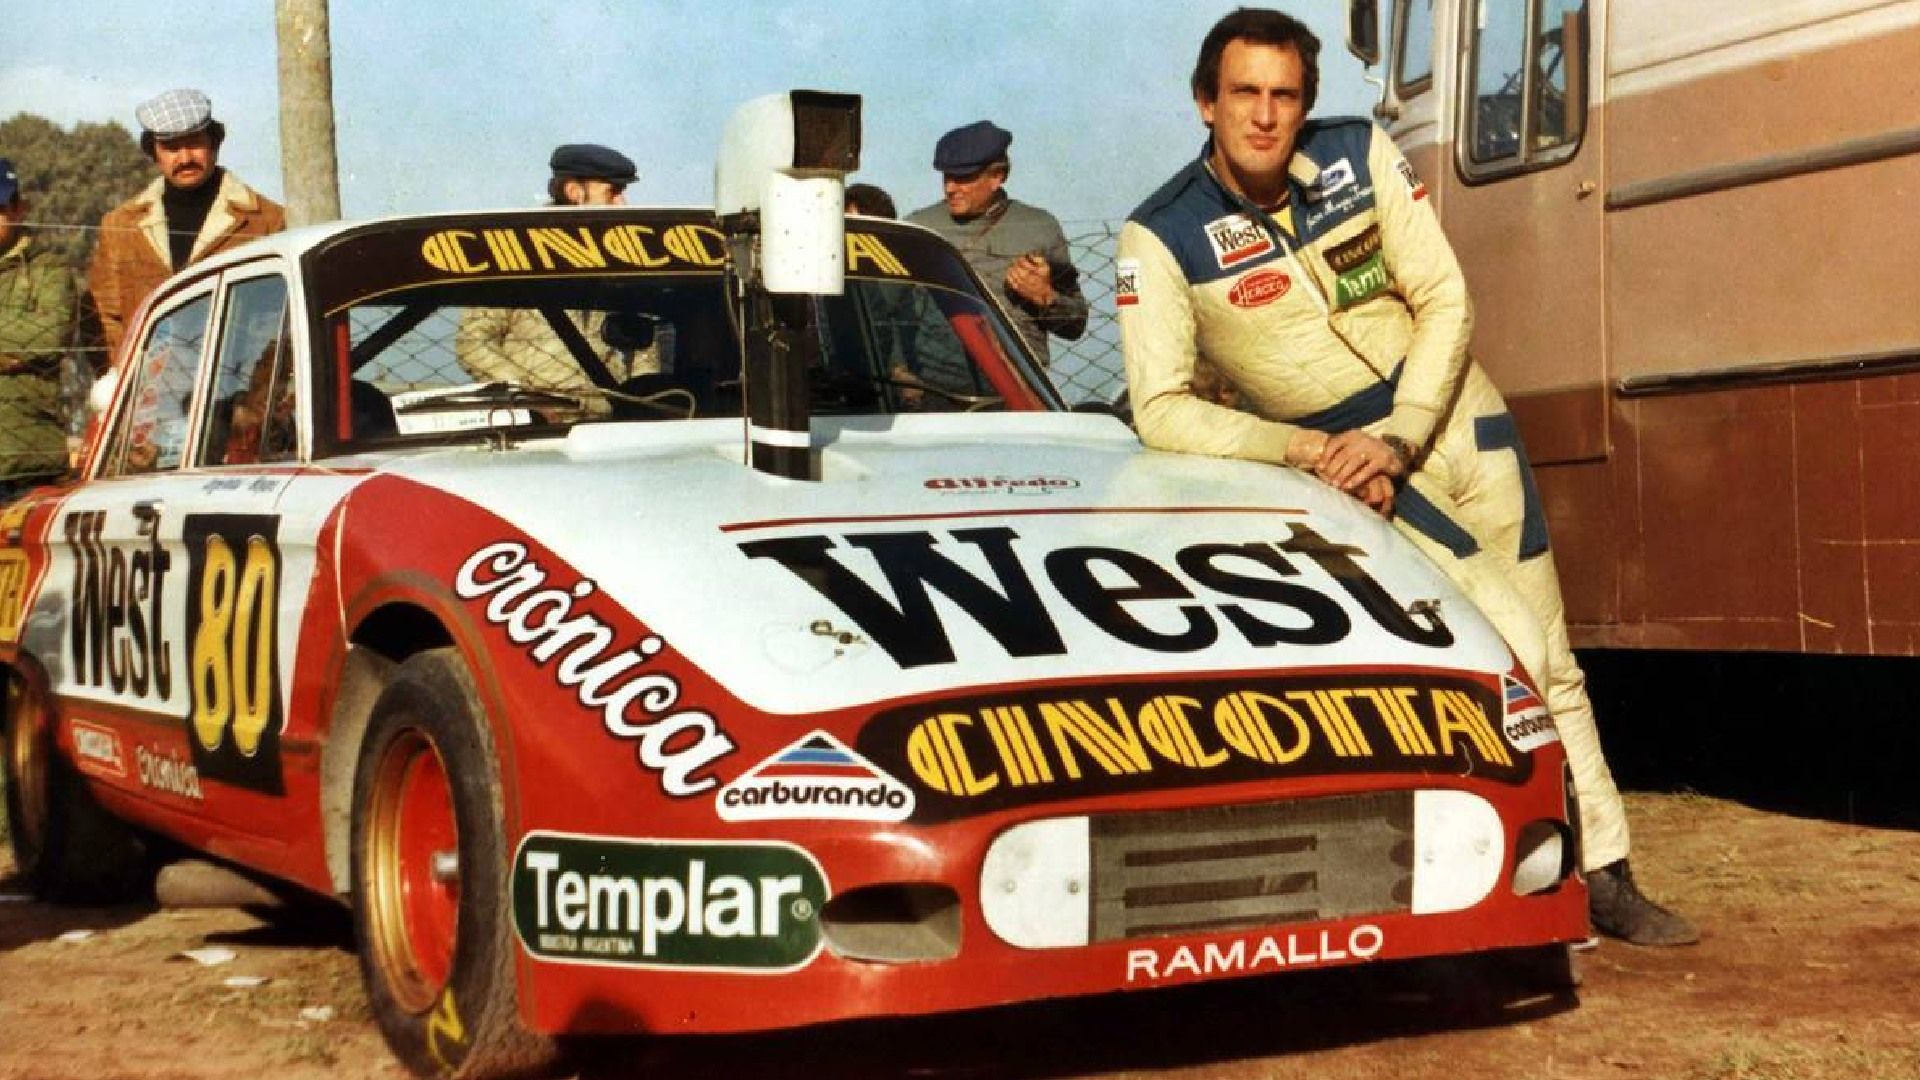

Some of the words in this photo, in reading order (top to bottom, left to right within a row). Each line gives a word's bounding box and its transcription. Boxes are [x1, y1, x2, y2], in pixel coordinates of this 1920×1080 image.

[420, 224, 911, 276] CINCOA
[1213, 224, 1267, 253] West
[64, 510, 171, 702] West
[193, 533, 274, 758] 80
[738, 522, 1455, 670] West
[906, 684, 1513, 796] CINCOTTA
[723, 781, 907, 811] carburando
[526, 851, 803, 956] Templar
[1127, 924, 1385, 982] RAMALLO
